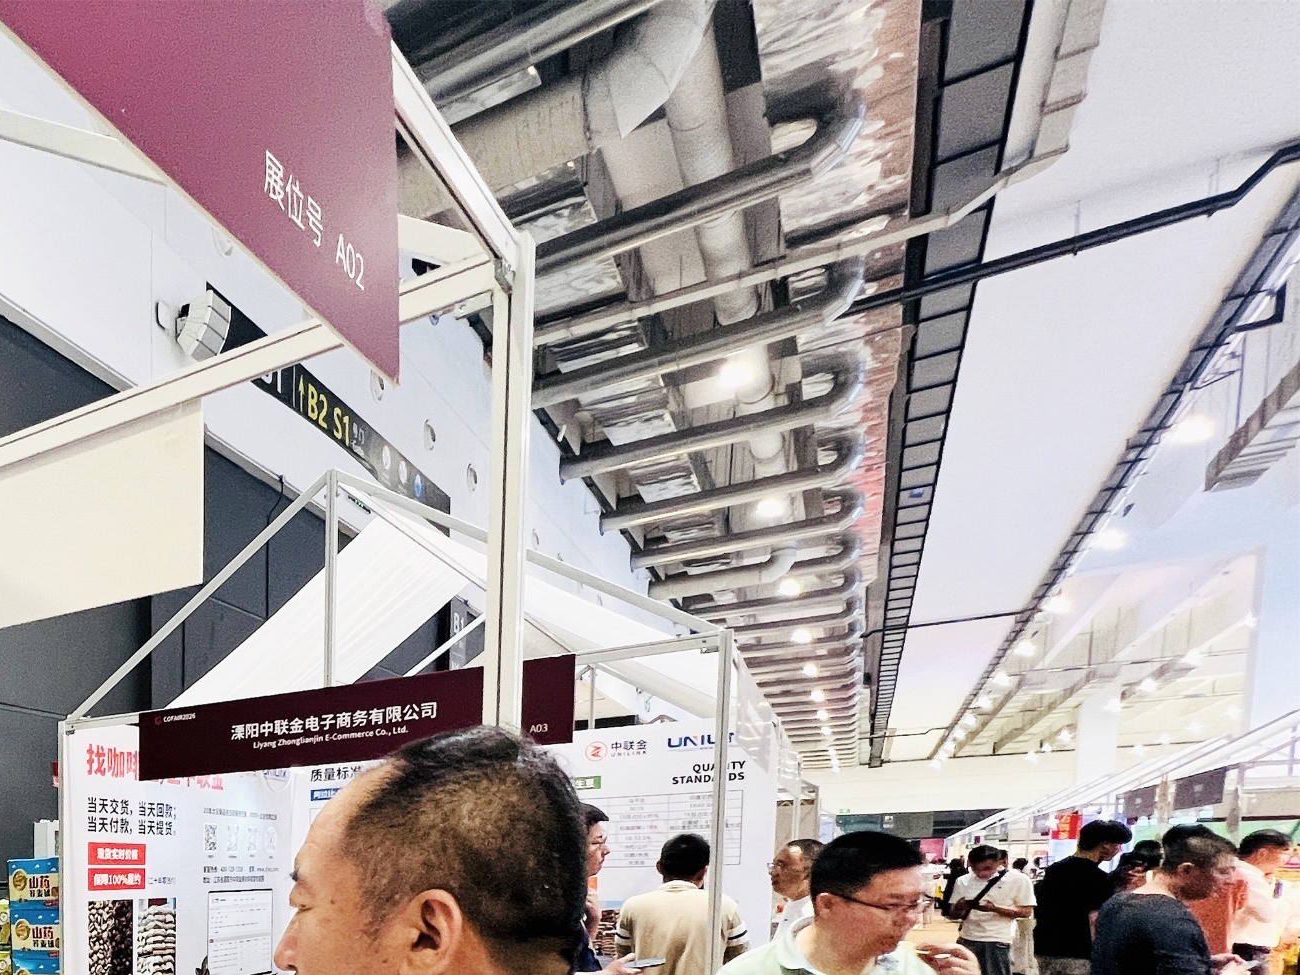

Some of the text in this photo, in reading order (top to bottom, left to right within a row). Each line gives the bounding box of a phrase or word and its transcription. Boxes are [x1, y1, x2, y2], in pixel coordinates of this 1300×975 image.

[264, 150, 364, 290] 展位号 A02
[308, 383, 328, 429] B2
[333, 407, 349, 447] S1
[231, 702, 438, 741] 溧阳中联金电子商务有限公司
[529, 722, 549, 734] A03
[253, 740, 276, 749] Liyang
[277, 734, 324, 748] Zhonglianjin
[325, 729, 373, 742] E-Commerce
[393, 726, 408, 736] Ltd.
[611, 739, 647, 751] 中联金
